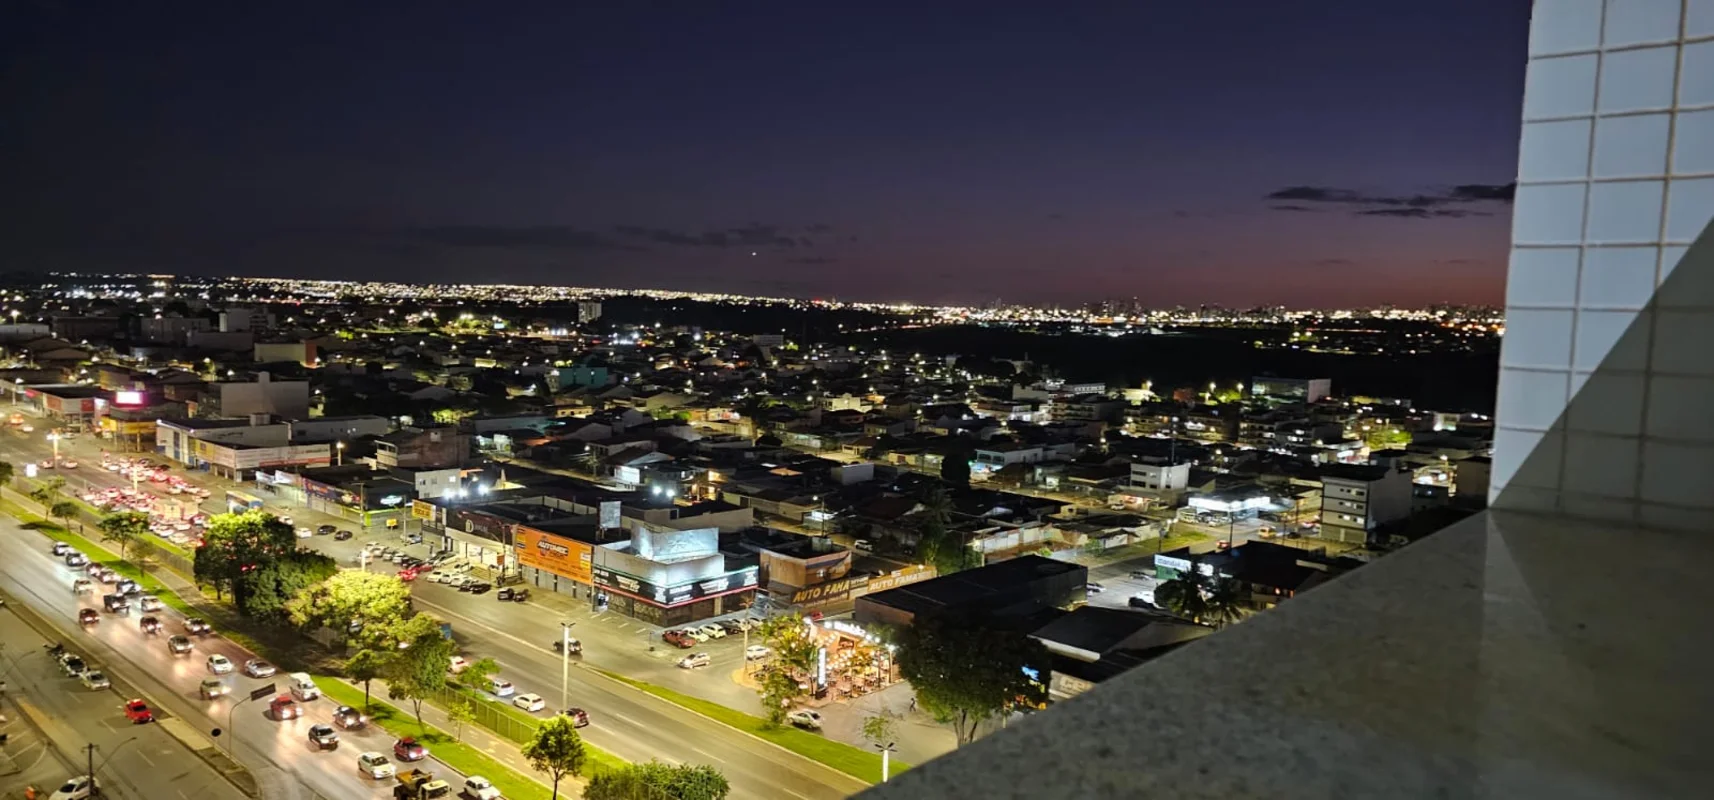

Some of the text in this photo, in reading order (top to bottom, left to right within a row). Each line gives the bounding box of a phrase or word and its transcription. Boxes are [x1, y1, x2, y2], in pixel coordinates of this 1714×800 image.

[792, 588, 821, 603] AUTO
[823, 580, 850, 596] FAMA
[869, 579, 893, 591] AUTO
[894, 573, 918, 585] FAMA
